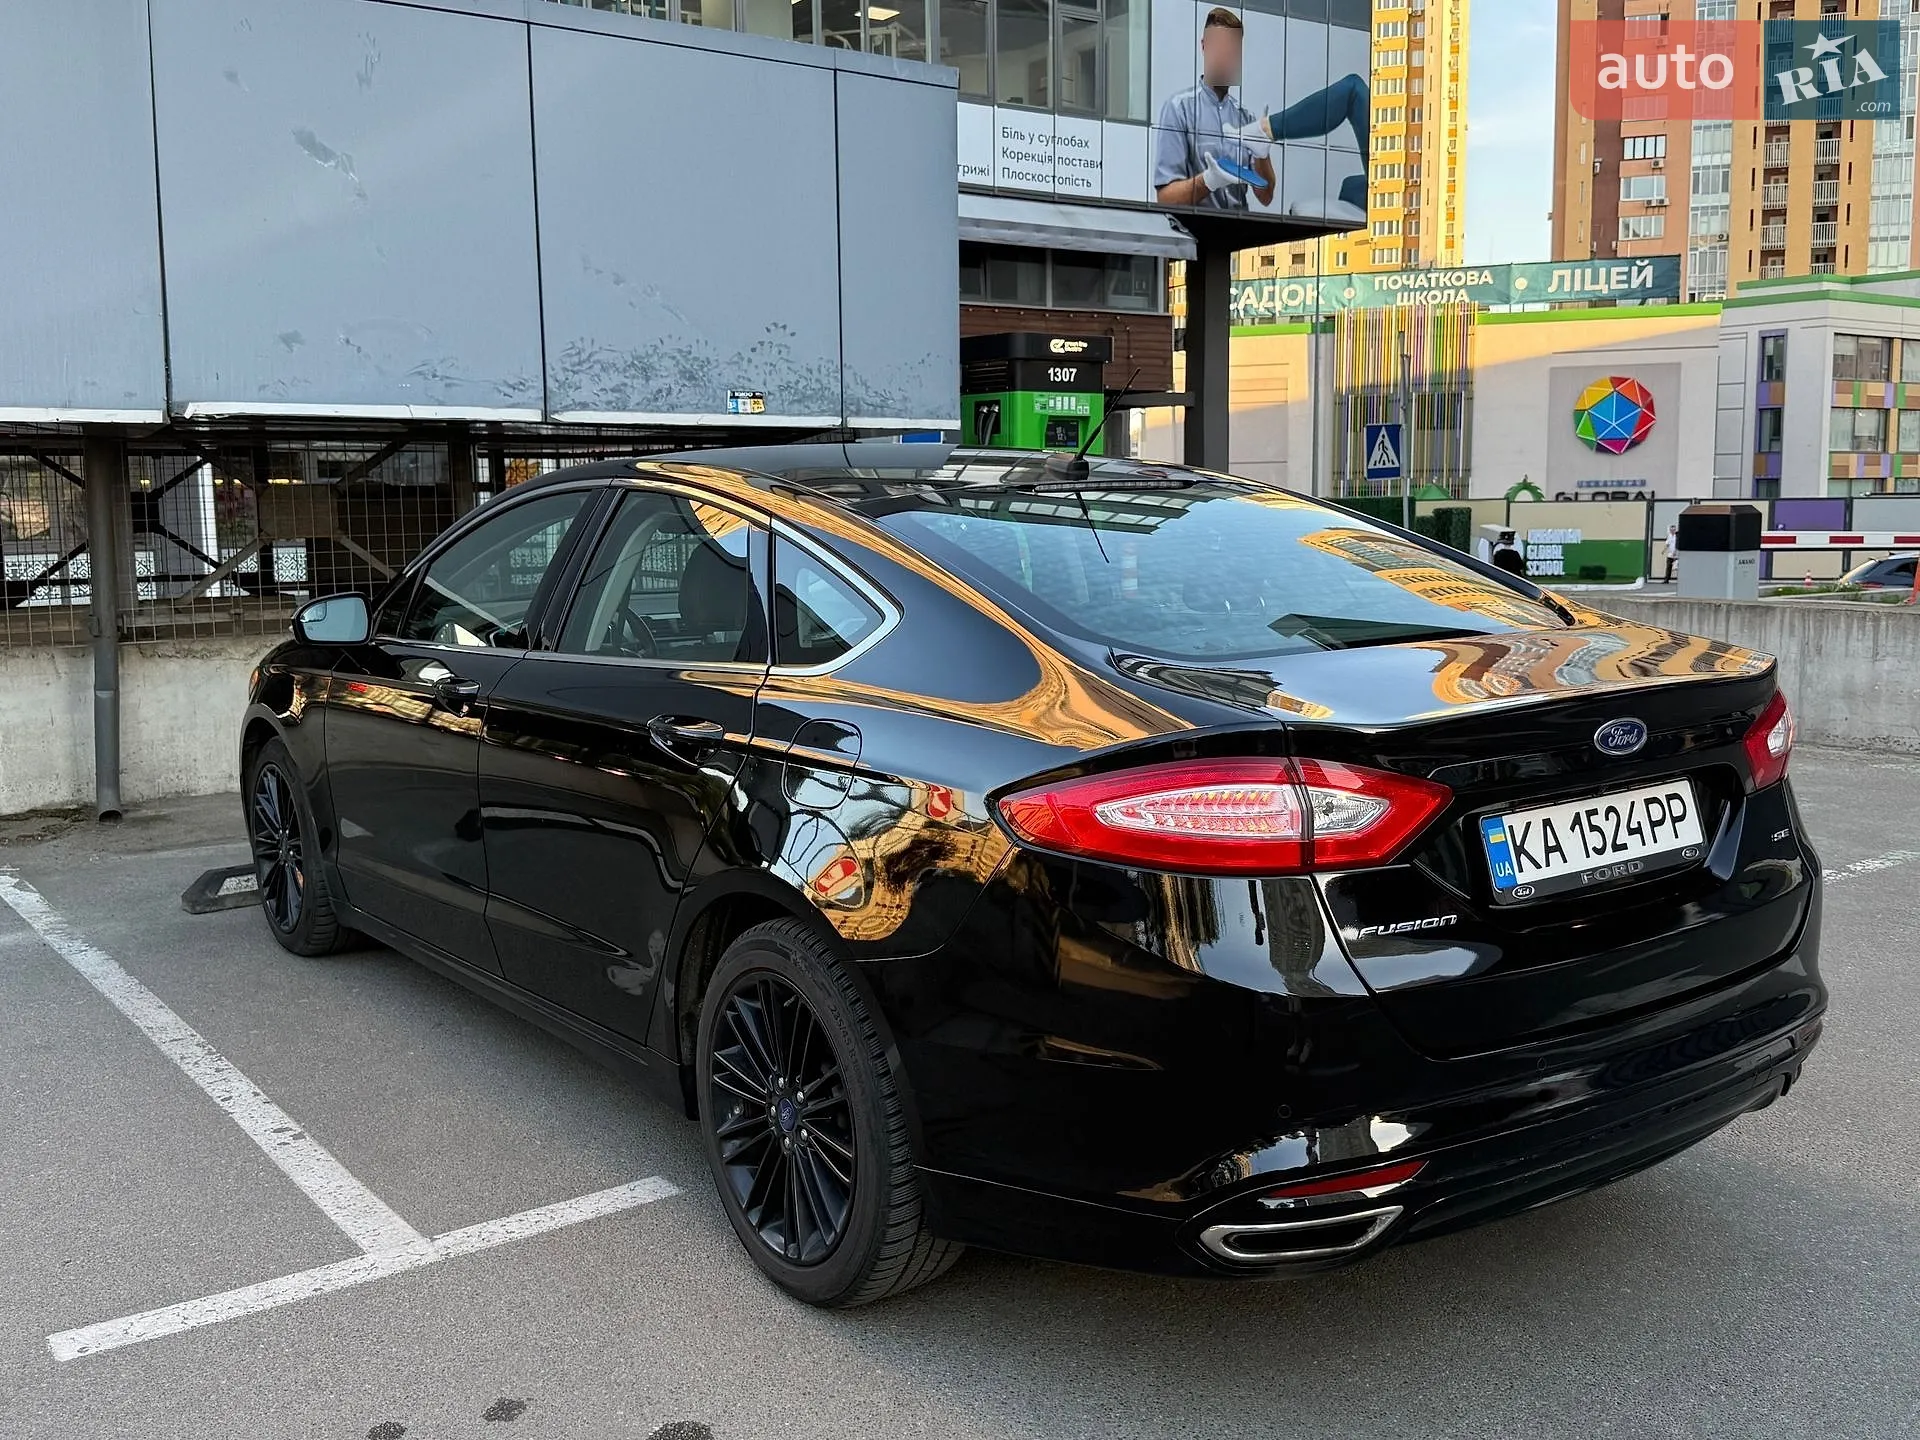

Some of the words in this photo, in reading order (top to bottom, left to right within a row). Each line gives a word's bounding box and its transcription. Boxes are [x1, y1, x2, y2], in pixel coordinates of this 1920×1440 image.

[1002, 126, 1025, 141] Біль
[1028, 132, 1035, 144] у
[1038, 133, 1090, 149] суглобах
[1002, 147, 1053, 164] Корекція
[1057, 156, 1103, 170] постави
[1002, 167, 1092, 188] Плоскостопість
[1374, 269, 1494, 291] ПОЧАТКОВА
[1548, 259, 1654, 294] ЛІЦЕЙ
[1396, 288, 1470, 305] ШКОЛА
[1047, 367, 1077, 382] 1307
[1525, 560, 1566, 576] SCHOOL
[1496, 862, 1514, 878] UA
[1580, 860, 1645, 886] FORD
[1358, 914, 1458, 940] FUSION
